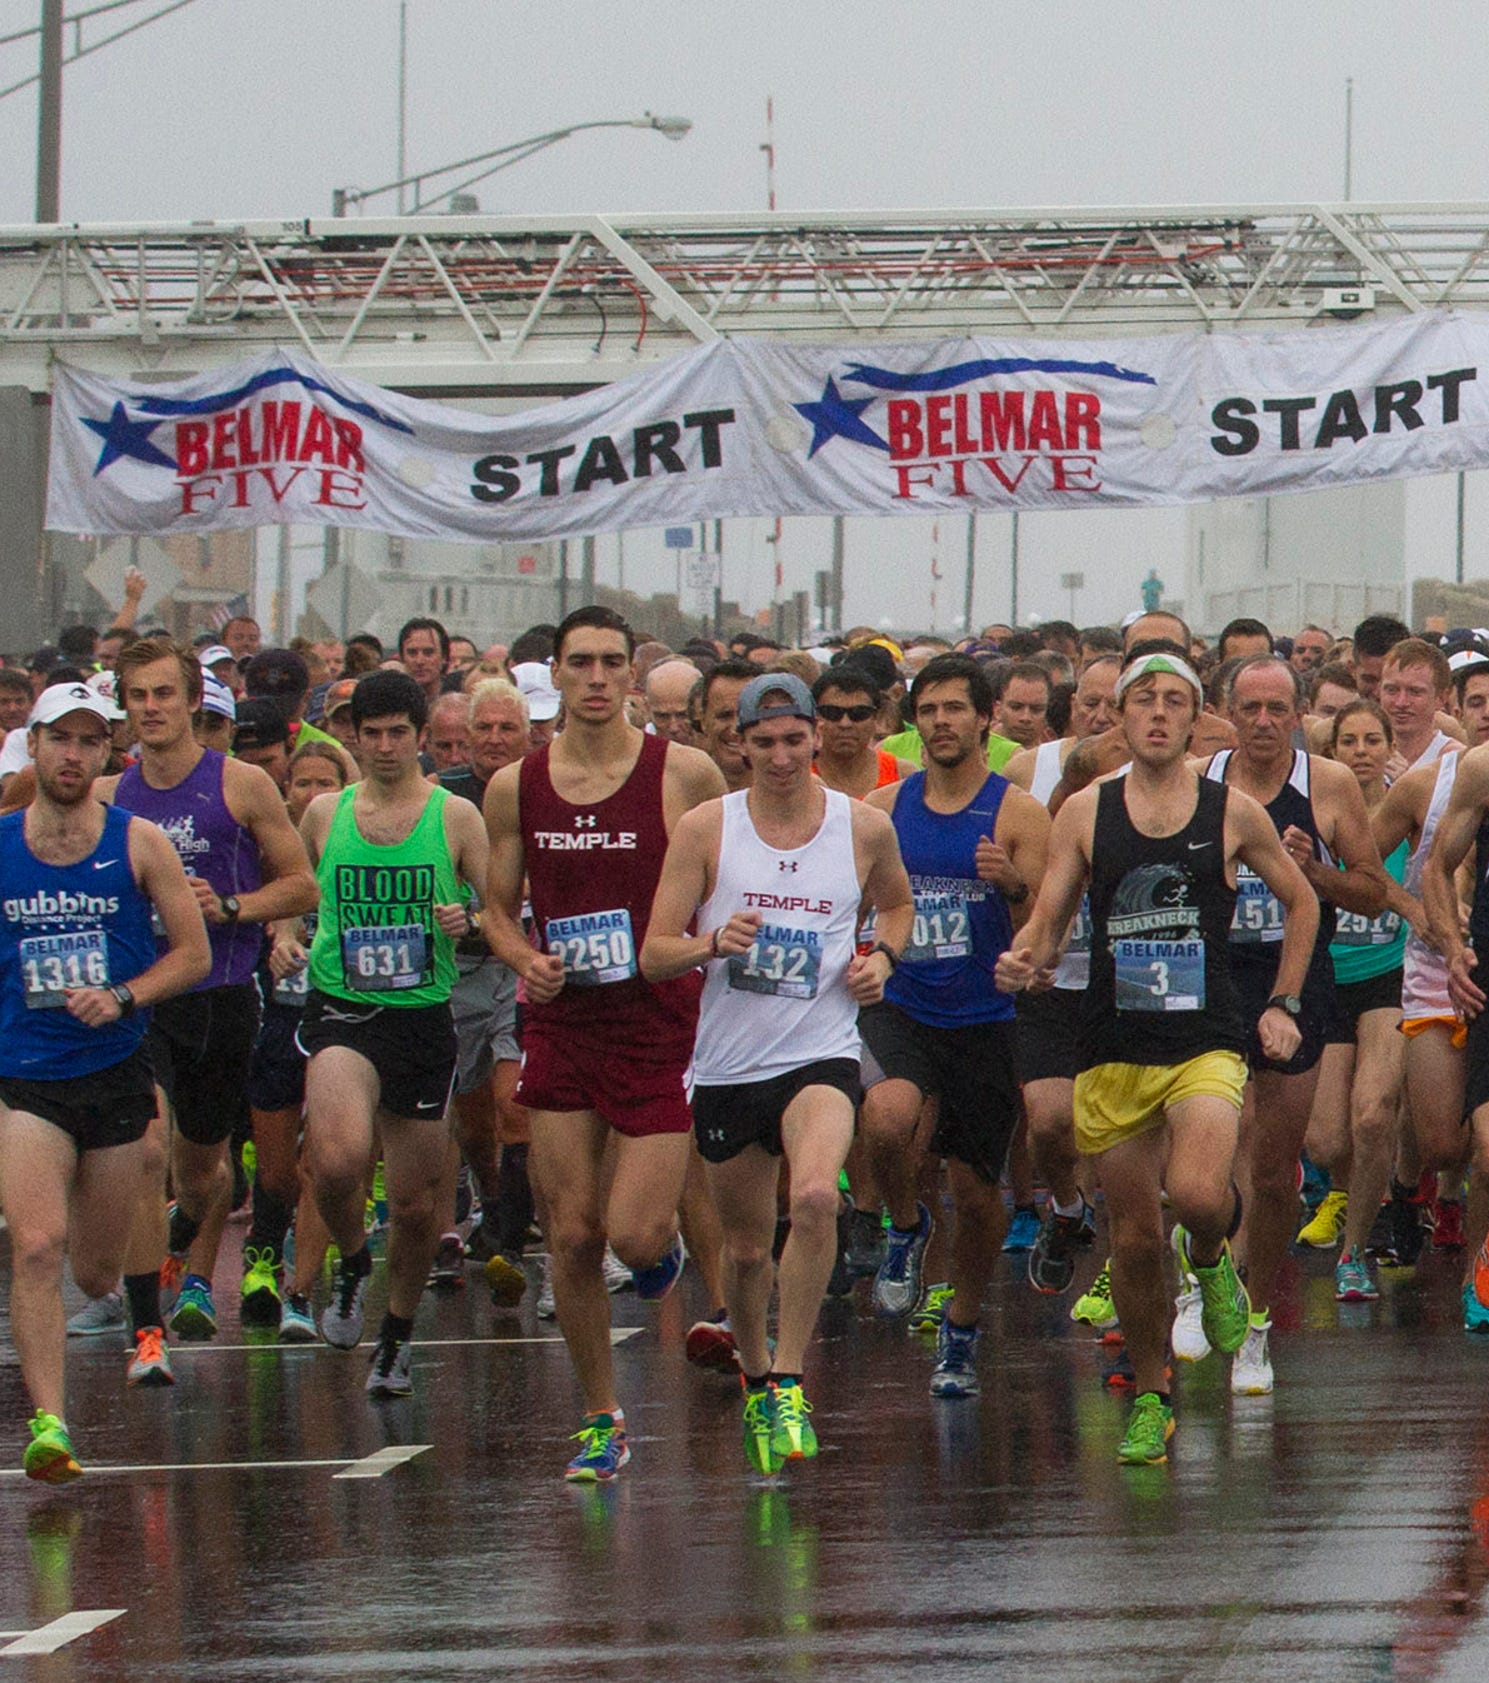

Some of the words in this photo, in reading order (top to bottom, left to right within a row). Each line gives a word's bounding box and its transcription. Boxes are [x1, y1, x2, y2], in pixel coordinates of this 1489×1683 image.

[888, 390, 1101, 460] BELMAR
[1210, 367, 1477, 457] START
[175, 400, 365, 477] BELMAR
[470, 408, 735, 503] START
[178, 464, 367, 516] FIVE
[890, 455, 1101, 499] FIVE
[534, 832, 637, 850] TEMPLE
[340, 868, 432, 900] BLOOD
[343, 904, 430, 929] SWEAT
[743, 892, 833, 915] TEMPLE
[913, 896, 961, 911] LMAR
[350, 926, 420, 942] BELMAR
[550, 912, 624, 938] BELMAR
[755, 924, 818, 945] ELMAR
[912, 912, 968, 947] 012
[1106, 910, 1200, 936] BREAKNECK
[26, 934, 100, 955] BELMAR
[358, 944, 414, 977] 631
[549, 930, 632, 972] 2250
[1123, 942, 1199, 957] BELMAR
[24, 951, 107, 992] 1316
[743, 943, 808, 982] 132
[1150, 961, 1169, 995] 3
